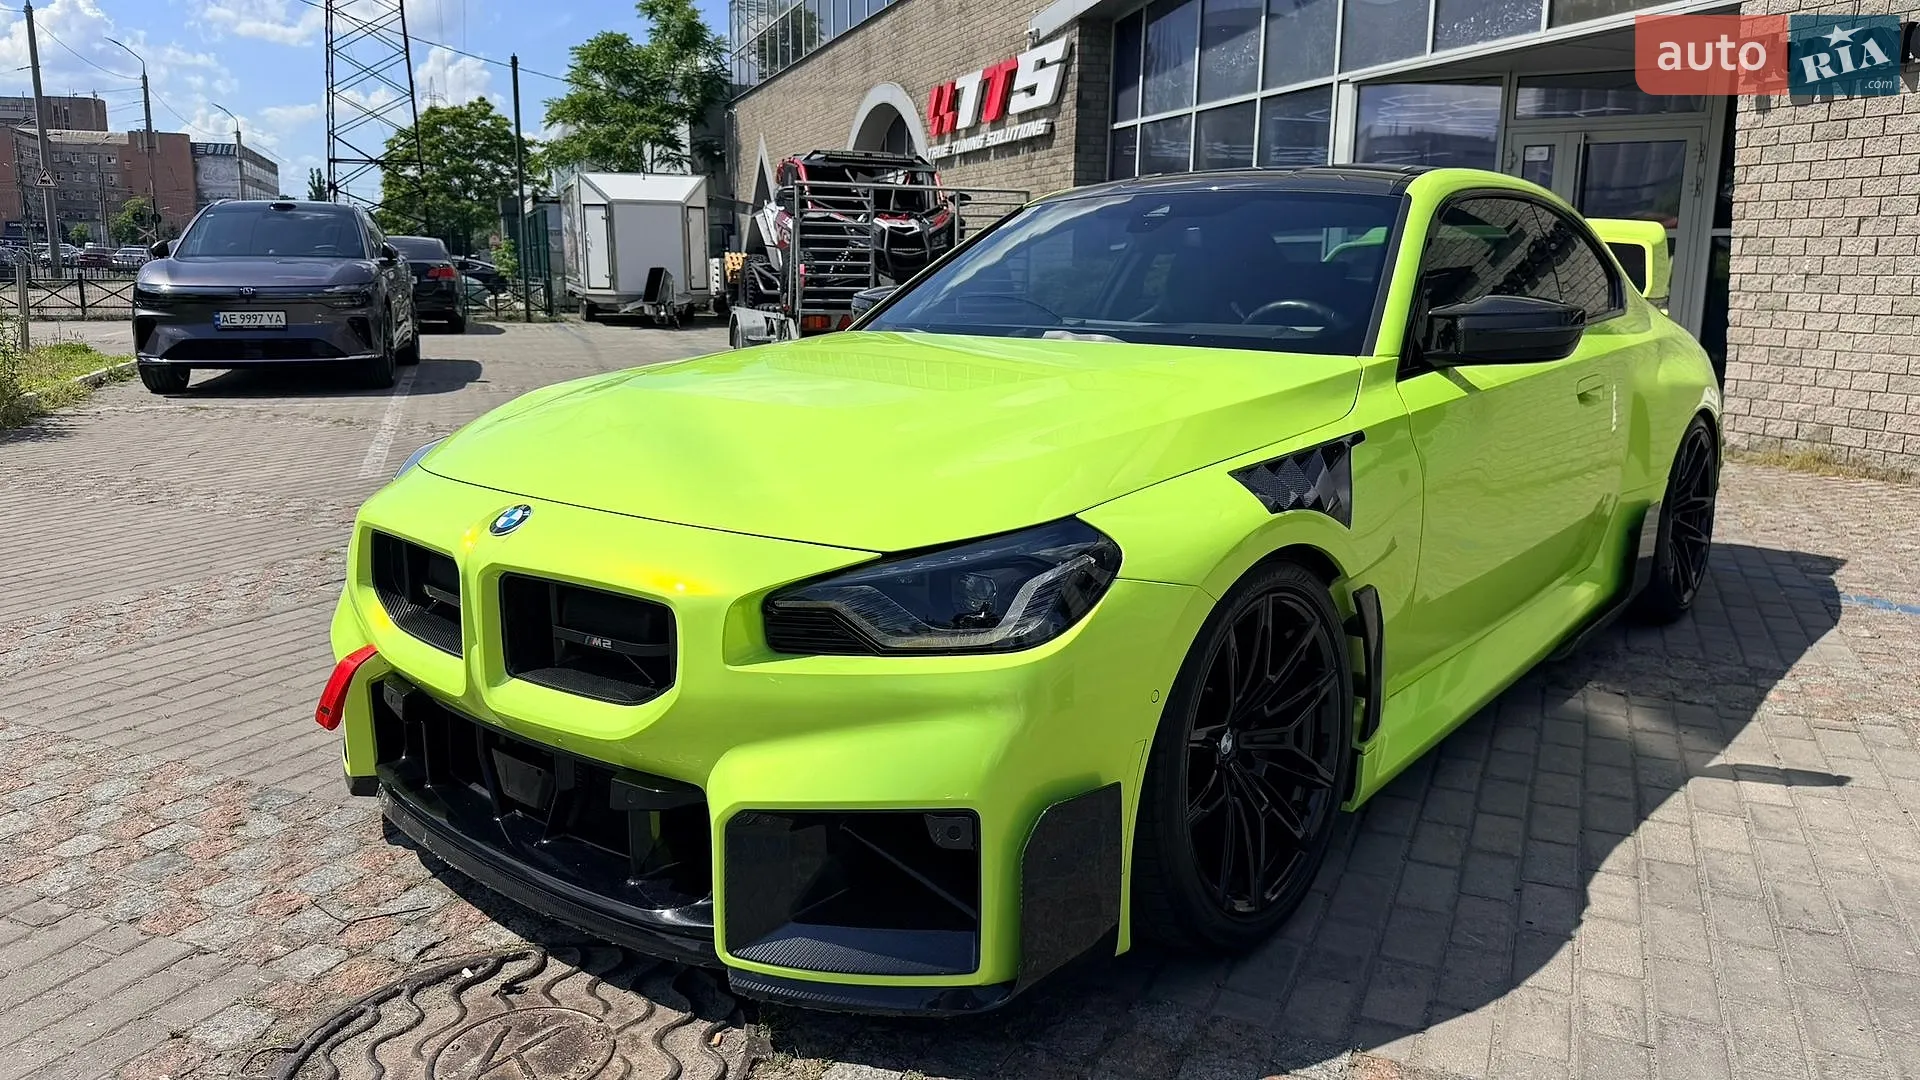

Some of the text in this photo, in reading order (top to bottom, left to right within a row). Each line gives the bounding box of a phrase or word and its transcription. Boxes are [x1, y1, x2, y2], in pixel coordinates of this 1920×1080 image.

[951, 134, 986, 155] TUNING
[985, 118, 1049, 147] SOLUTIONS
[221, 314, 237, 324] AE
[240, 314, 264, 324] 9997
[267, 314, 284, 324] YA
